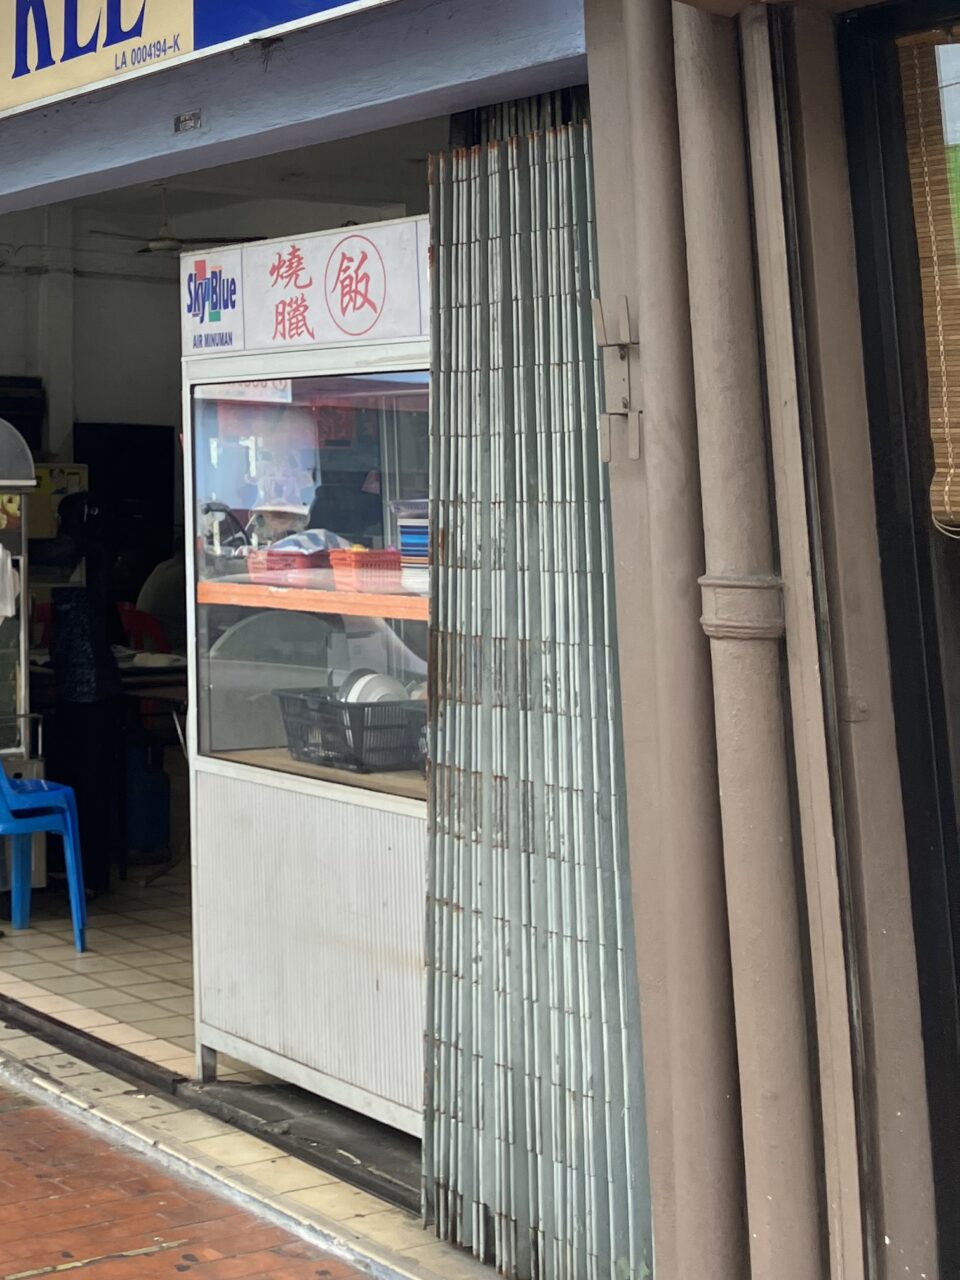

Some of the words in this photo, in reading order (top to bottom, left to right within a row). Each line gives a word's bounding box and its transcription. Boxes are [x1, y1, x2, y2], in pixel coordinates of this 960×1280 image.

[114, 51, 128, 71] LA
[332, 250, 378, 317] 飯
[192, 333, 203, 349] AIR
[204, 331, 233, 347] MINUMAN
